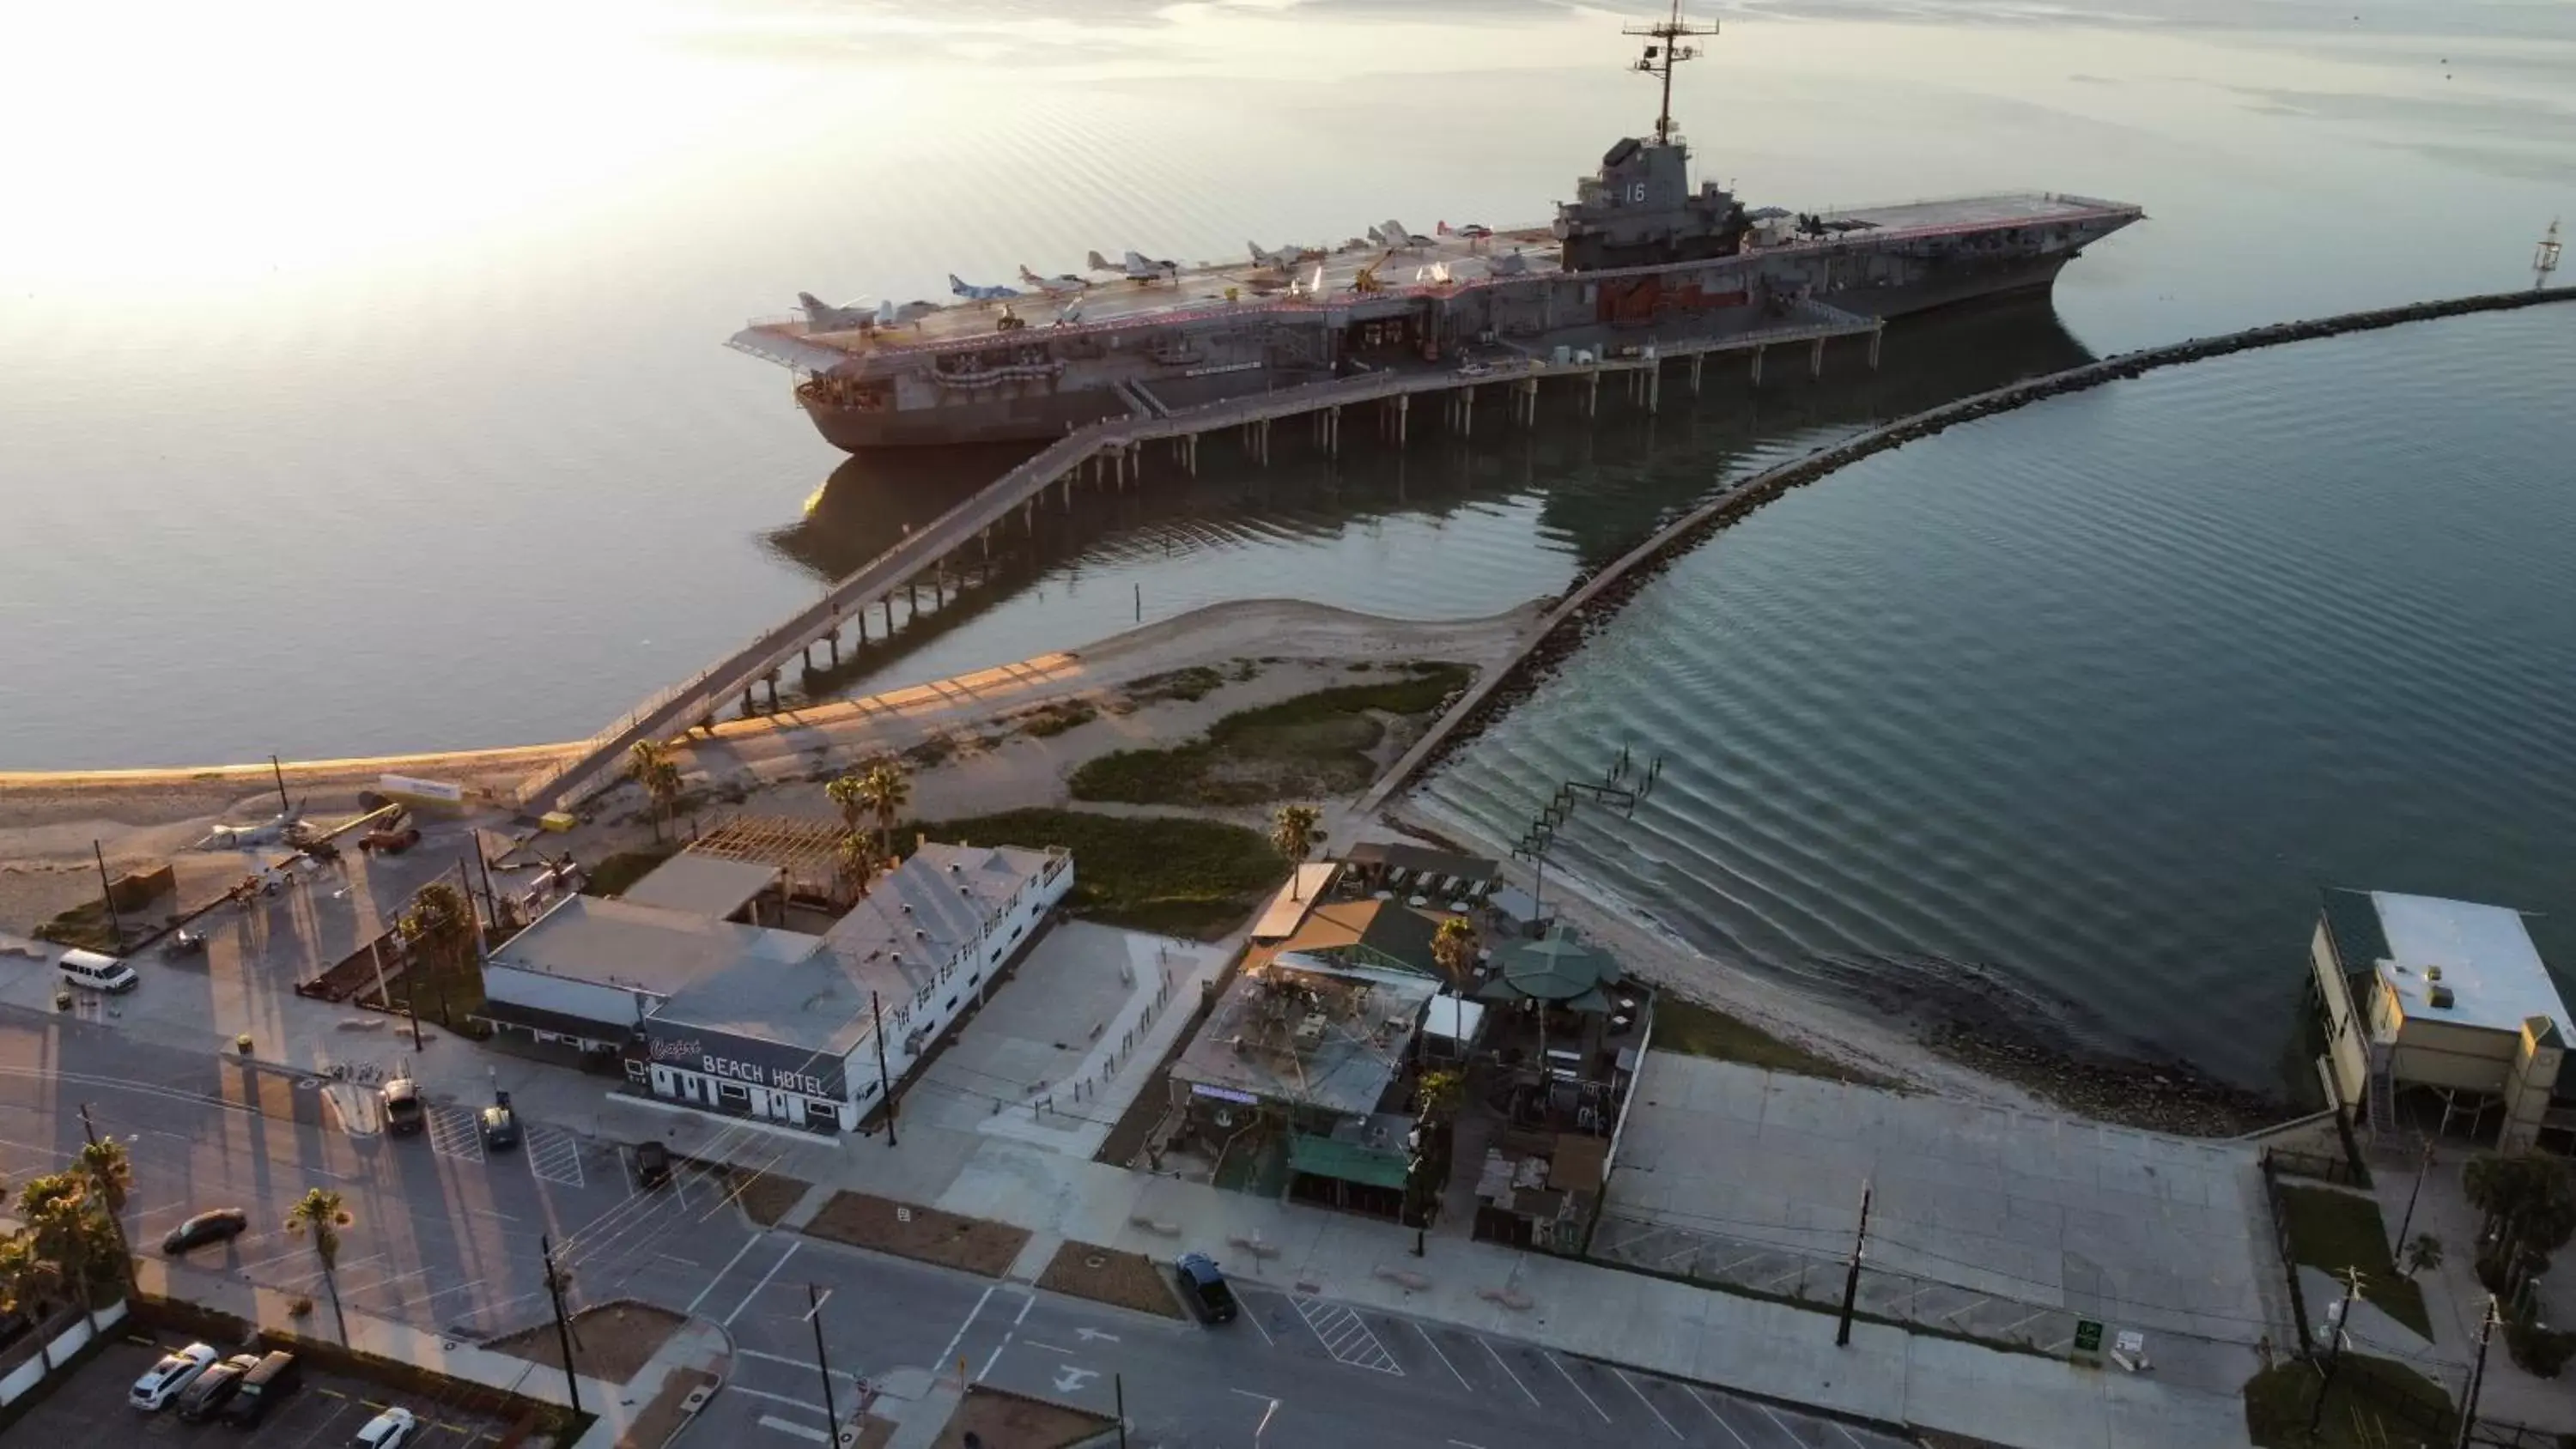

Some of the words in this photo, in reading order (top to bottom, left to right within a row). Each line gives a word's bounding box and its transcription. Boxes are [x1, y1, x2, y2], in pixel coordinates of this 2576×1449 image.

[1626, 182, 1645, 203] 16
[703, 1055, 763, 1083] BEACH
[772, 1067, 828, 1096] HOTEL
